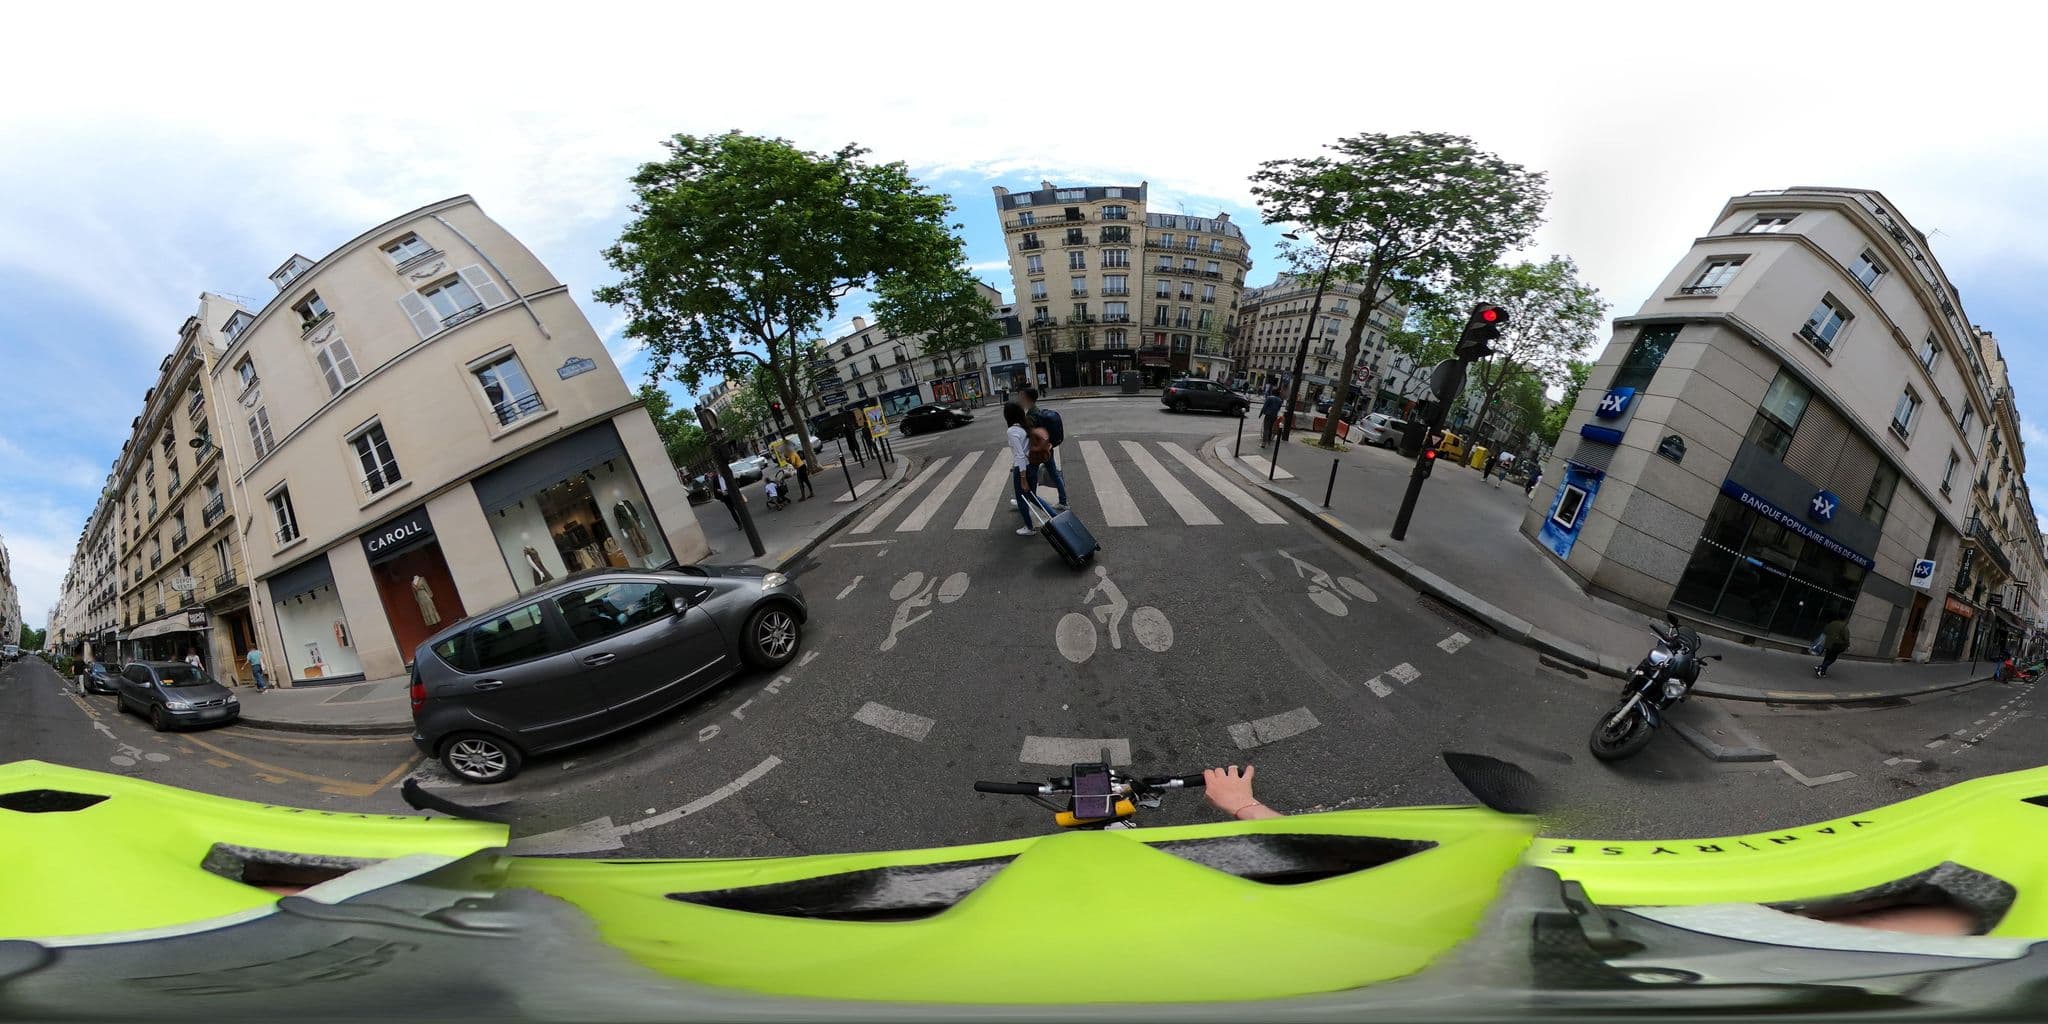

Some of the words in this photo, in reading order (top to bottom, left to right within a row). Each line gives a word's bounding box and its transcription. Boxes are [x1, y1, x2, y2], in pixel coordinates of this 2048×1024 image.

[368, 521, 422, 551] CAROLL
[1740, 492, 1781, 520] BANQUE
[1781, 514, 1825, 545] POPULAIRE
[1823, 536, 1842, 554] RIVES
[1841, 548, 1851, 559] DE
[1851, 553, 1868, 567] PARIS
